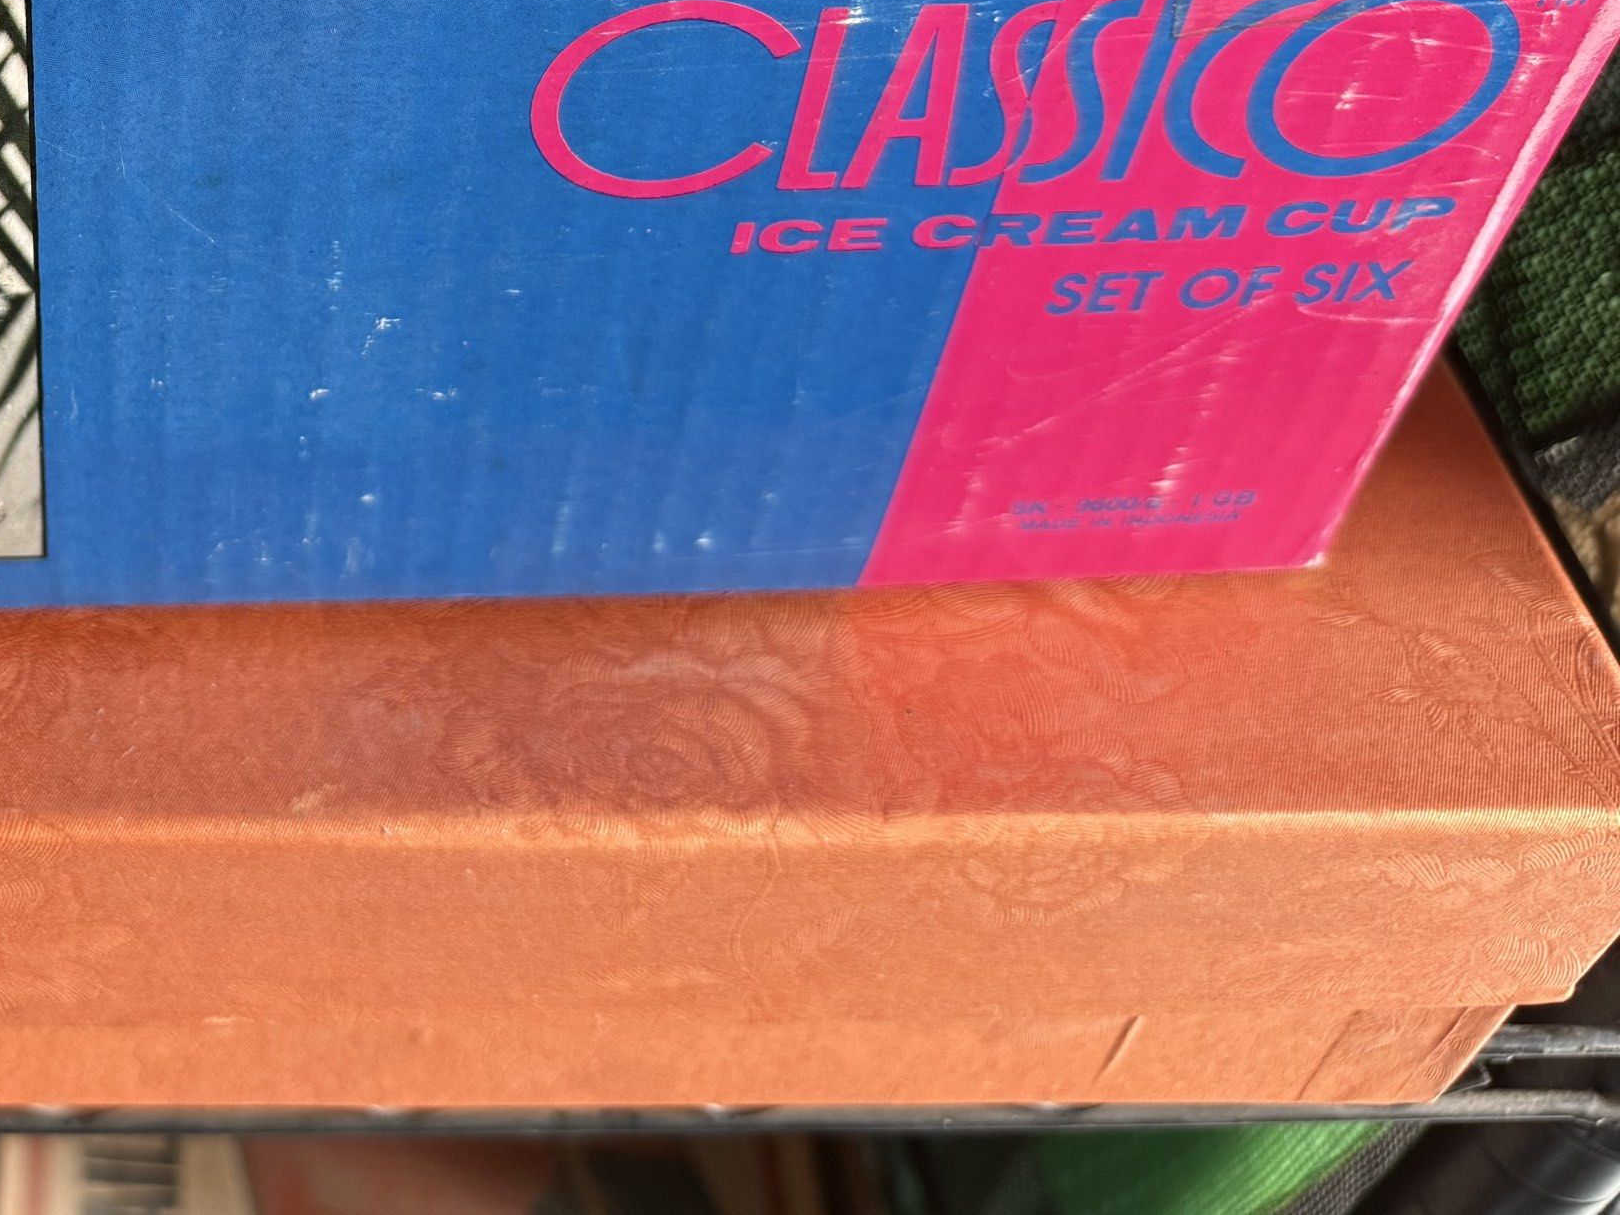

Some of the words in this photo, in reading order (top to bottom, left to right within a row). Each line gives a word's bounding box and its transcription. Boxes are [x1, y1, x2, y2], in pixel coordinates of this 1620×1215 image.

[729, 217, 887, 255] ICE
[911, 204, 1250, 249] CREAM
[1266, 196, 1457, 238] CUP
[1045, 269, 1164, 315] SET
[1179, 264, 1282, 308] OF
[1292, 258, 1415, 305] SIX
